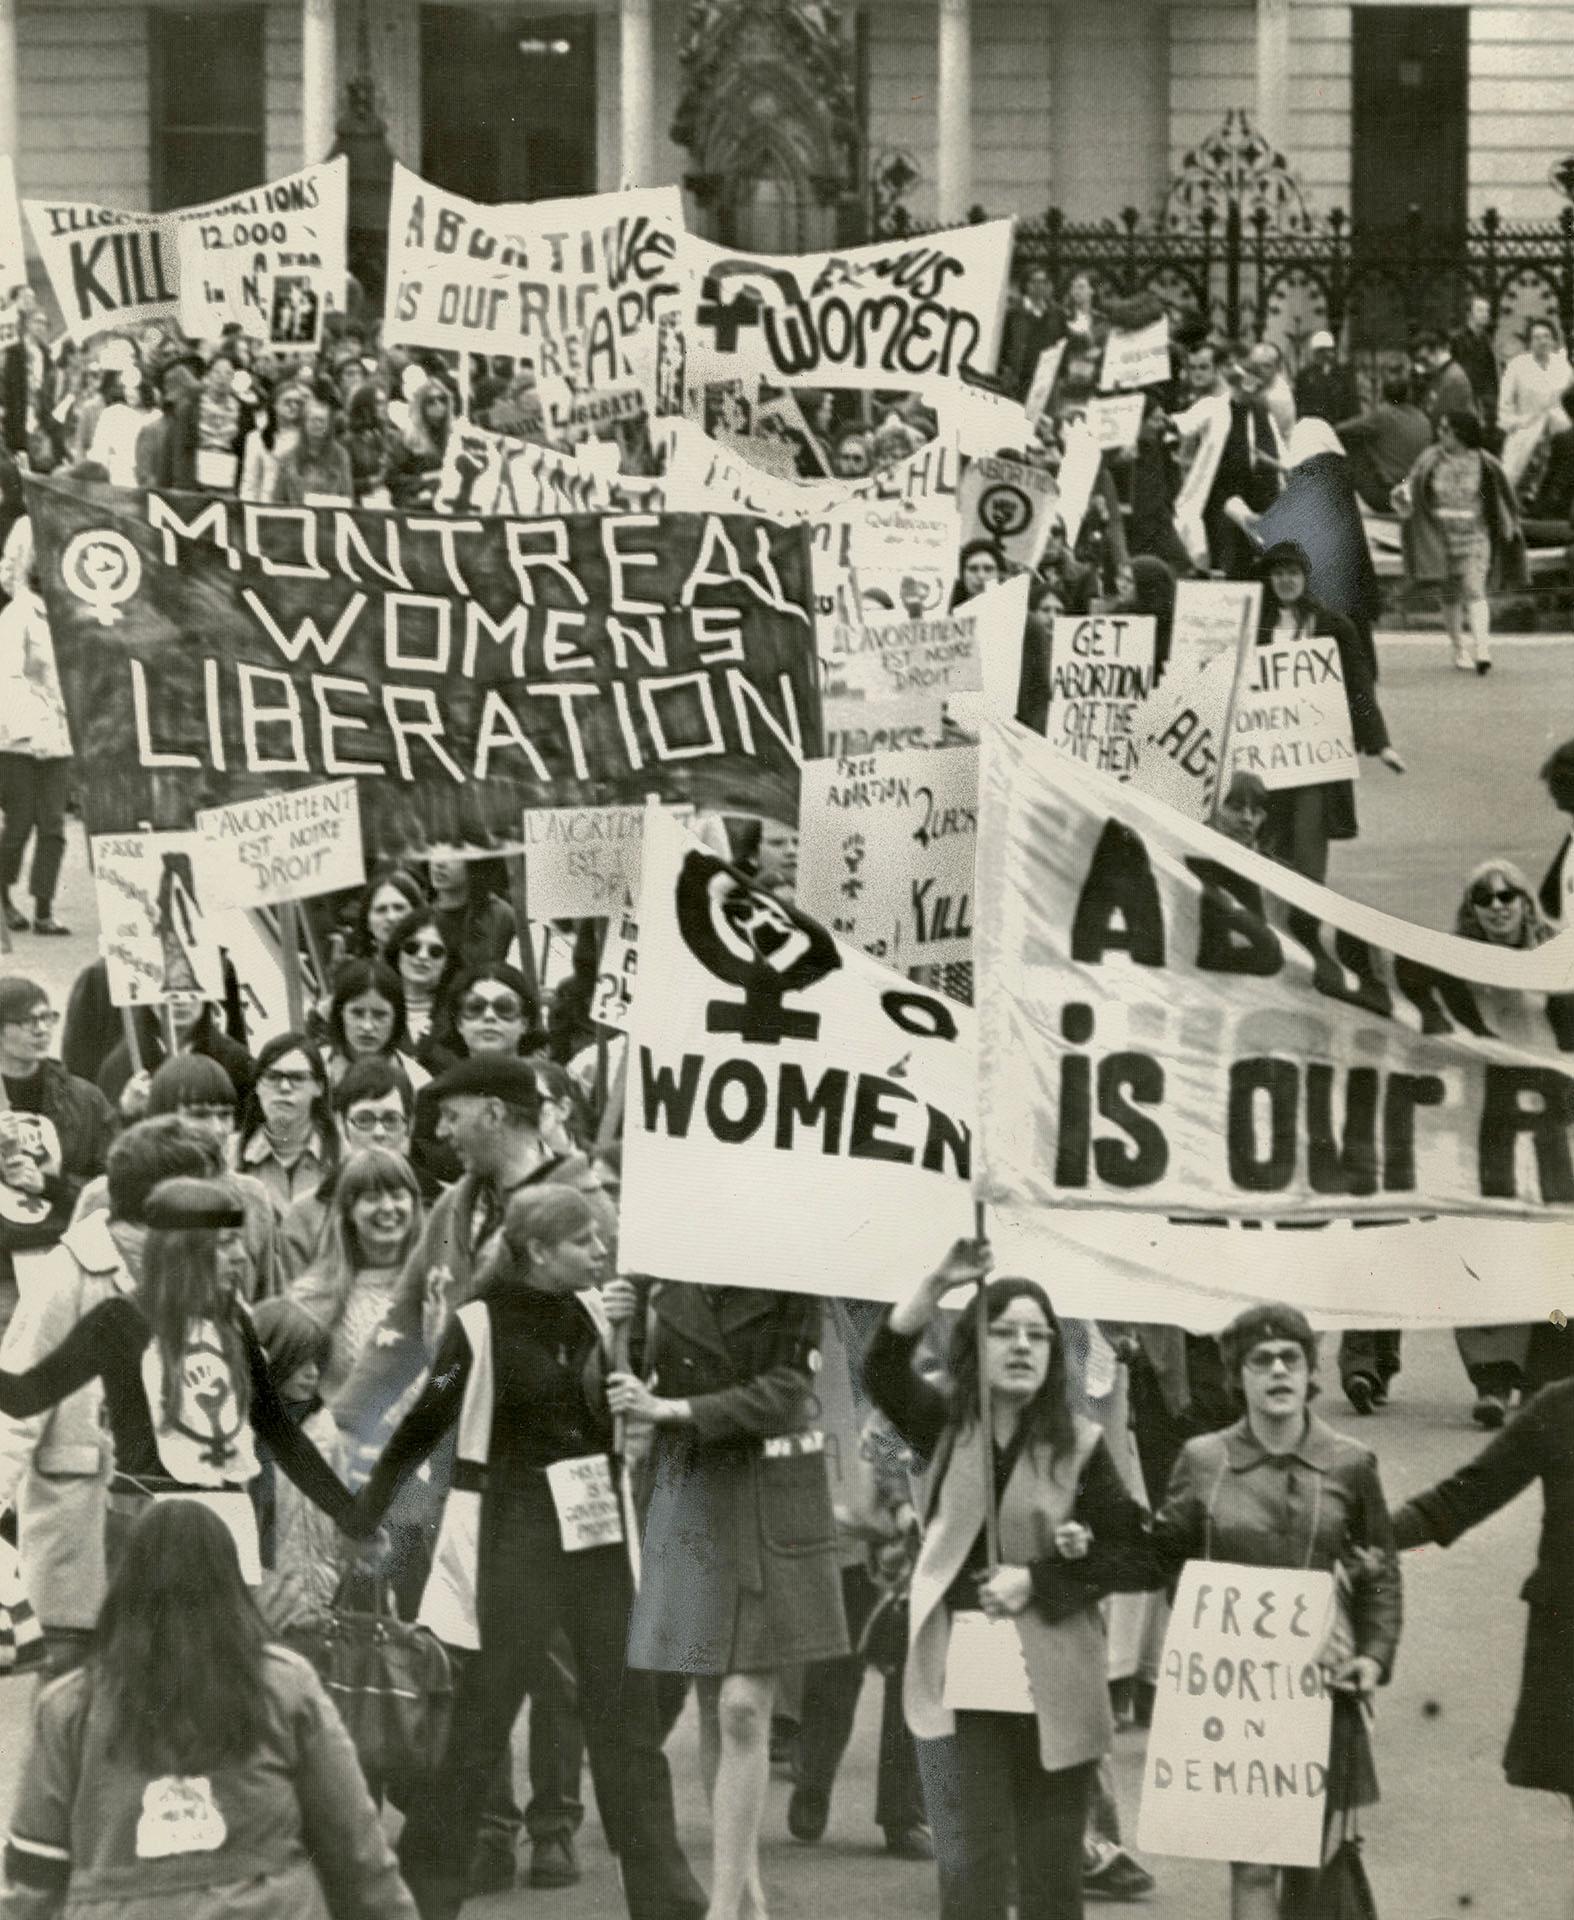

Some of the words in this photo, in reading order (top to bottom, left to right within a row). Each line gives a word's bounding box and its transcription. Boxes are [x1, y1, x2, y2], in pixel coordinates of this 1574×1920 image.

[69, 230, 179, 321] KILL
[147, 493, 811, 624] MONTREAL
[242, 590, 744, 678] WOMENS
[1072, 618, 1130, 658] GET
[1052, 661, 1152, 702] ABORTION
[130, 657, 804, 785] LIBERATION
[911, 877, 973, 944] KILL
[638, 1044, 974, 1182] WOMEN
[1193, 1583, 1311, 1639] FREE
[1202, 1715, 1266, 1743] ON
[1153, 1756, 1329, 1799] DEMAND
